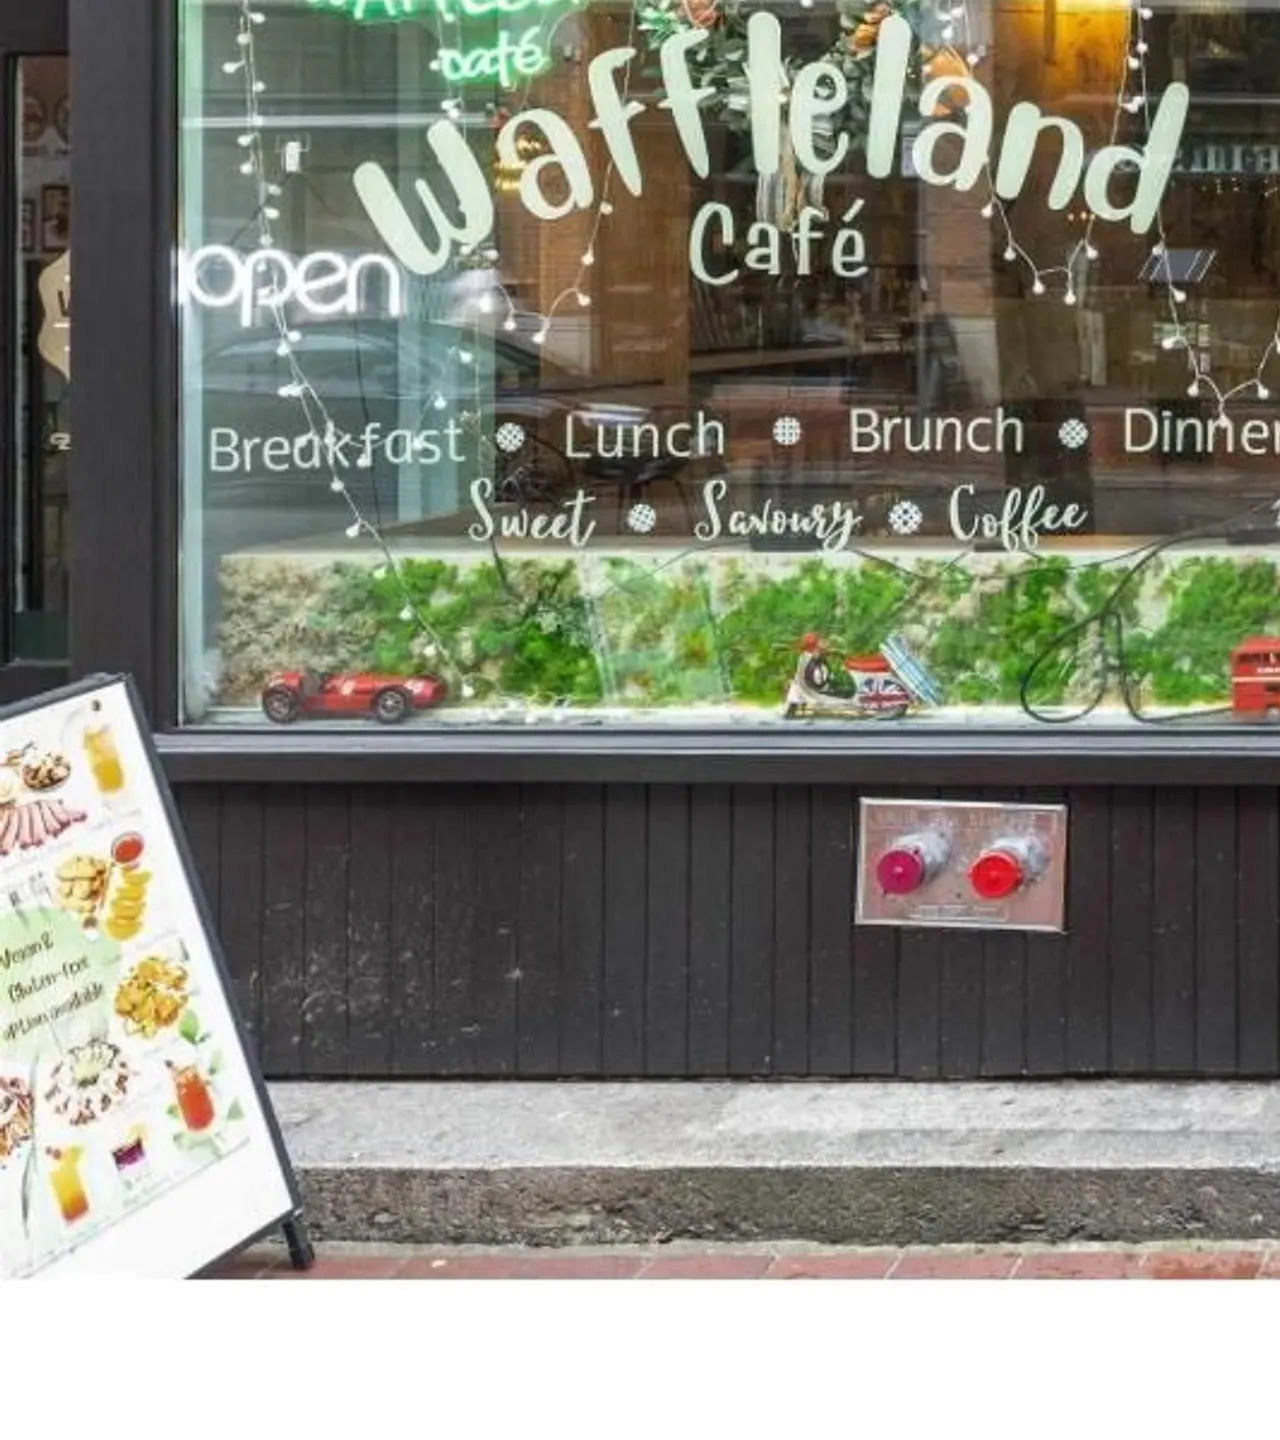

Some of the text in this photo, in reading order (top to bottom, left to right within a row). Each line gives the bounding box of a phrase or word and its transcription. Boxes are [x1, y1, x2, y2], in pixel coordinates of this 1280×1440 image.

[689, 199, 868, 286] Café
[186, 242, 402, 328] open
[209, 419, 466, 473] Breakfast
[564, 411, 725, 459] Lunch
[848, 407, 1024, 454] Brunch
[467, 476, 1089, 553] Sweet Savoury Coffee
